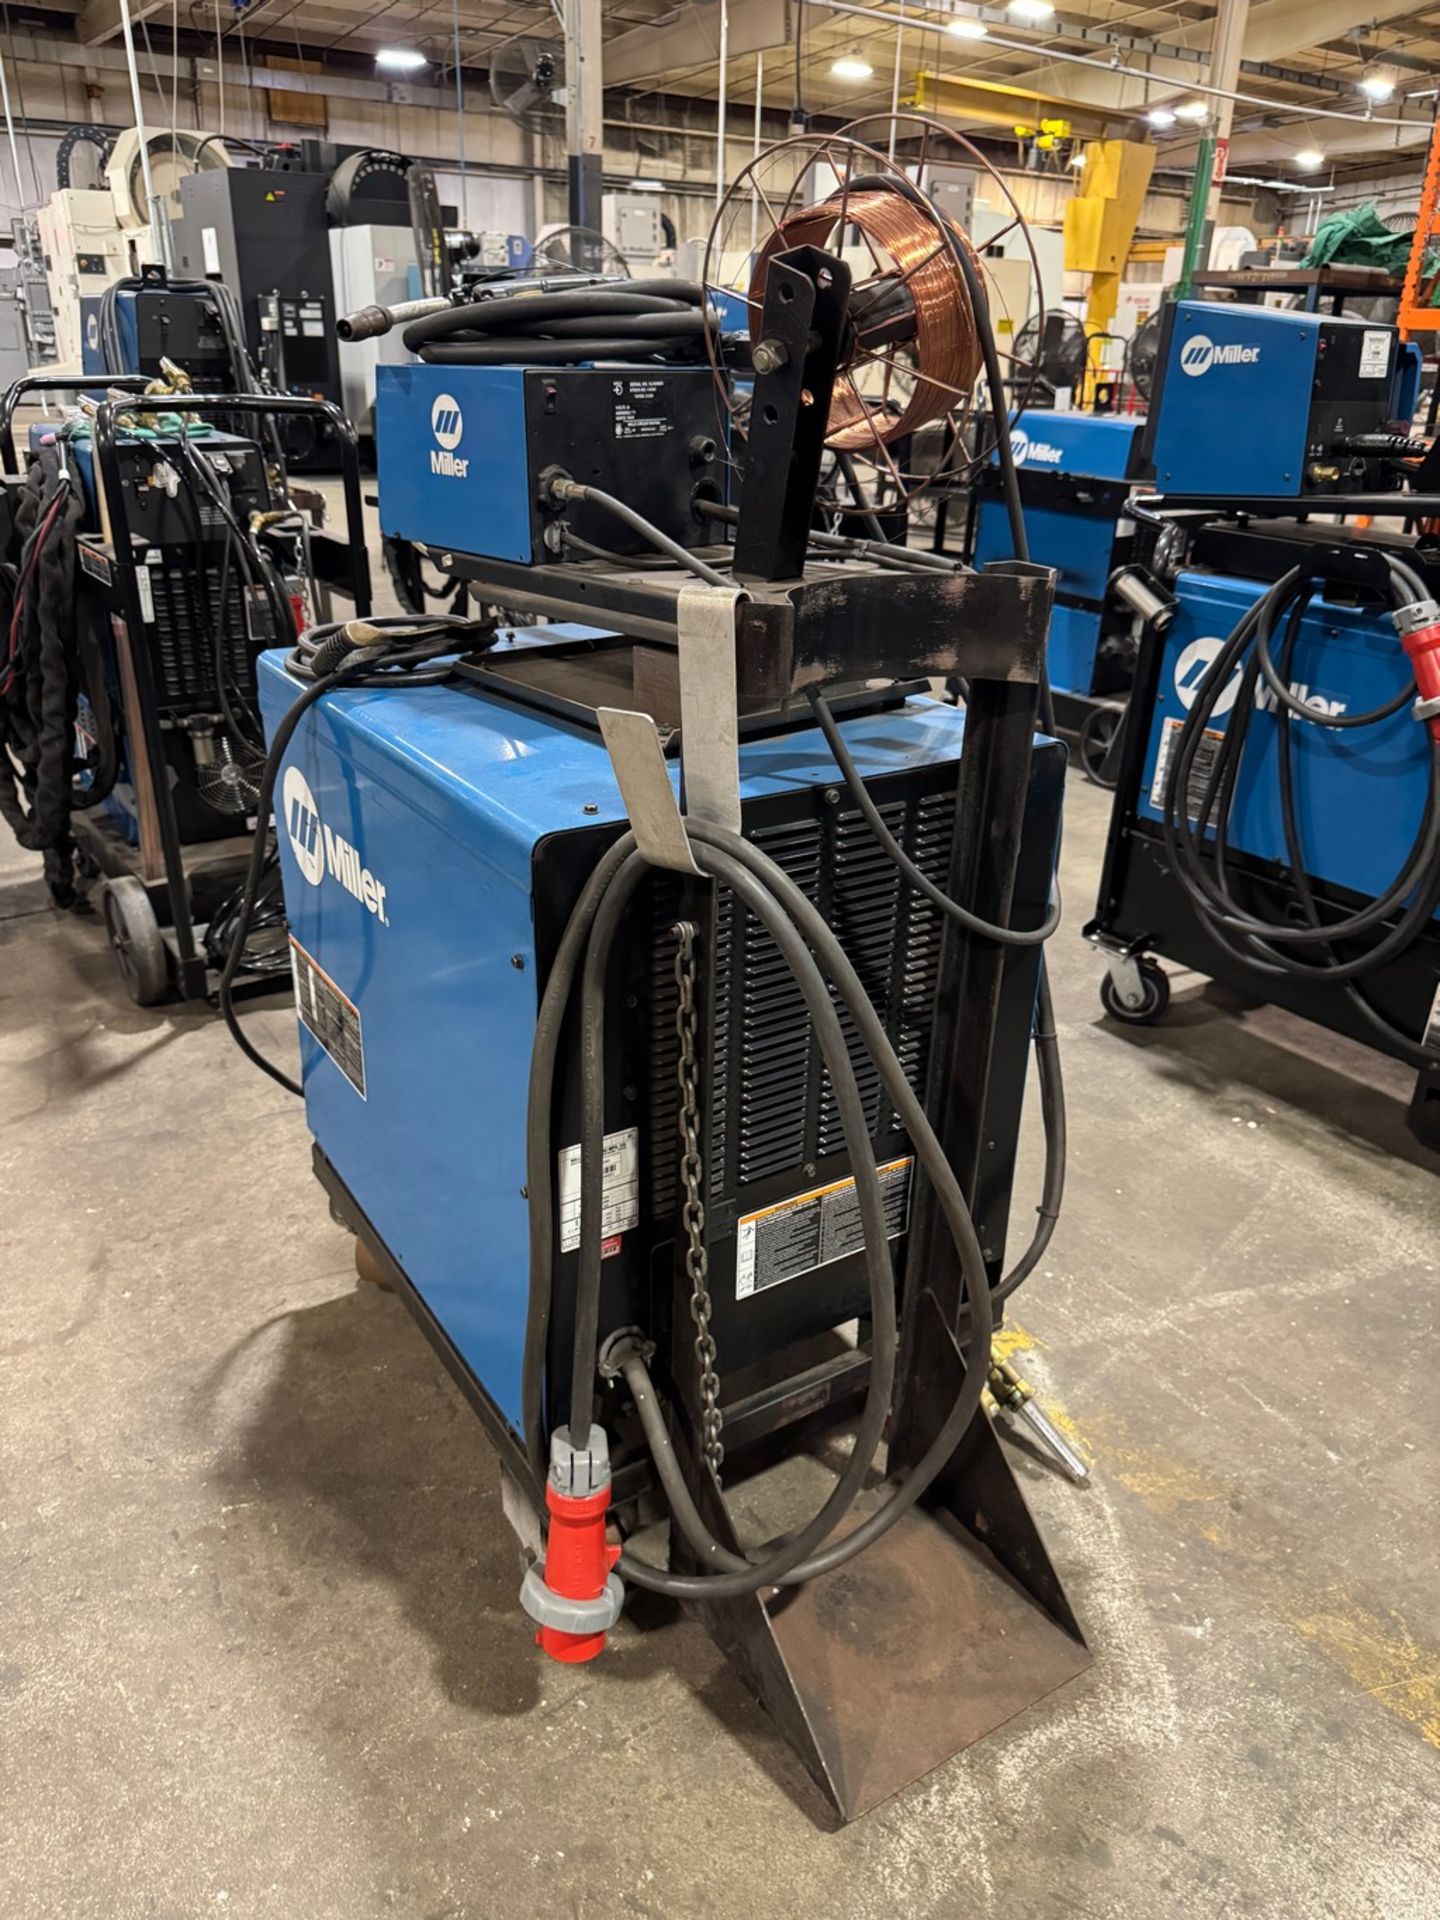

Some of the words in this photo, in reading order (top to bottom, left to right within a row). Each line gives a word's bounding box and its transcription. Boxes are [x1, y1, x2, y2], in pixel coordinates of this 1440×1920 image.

[1213, 344, 1260, 364] Miller
[430, 450, 469, 478] Miller
[1027, 441, 1063, 464] Miller
[1254, 673, 1346, 731] Mller
[323, 823, 387, 924] Miller
